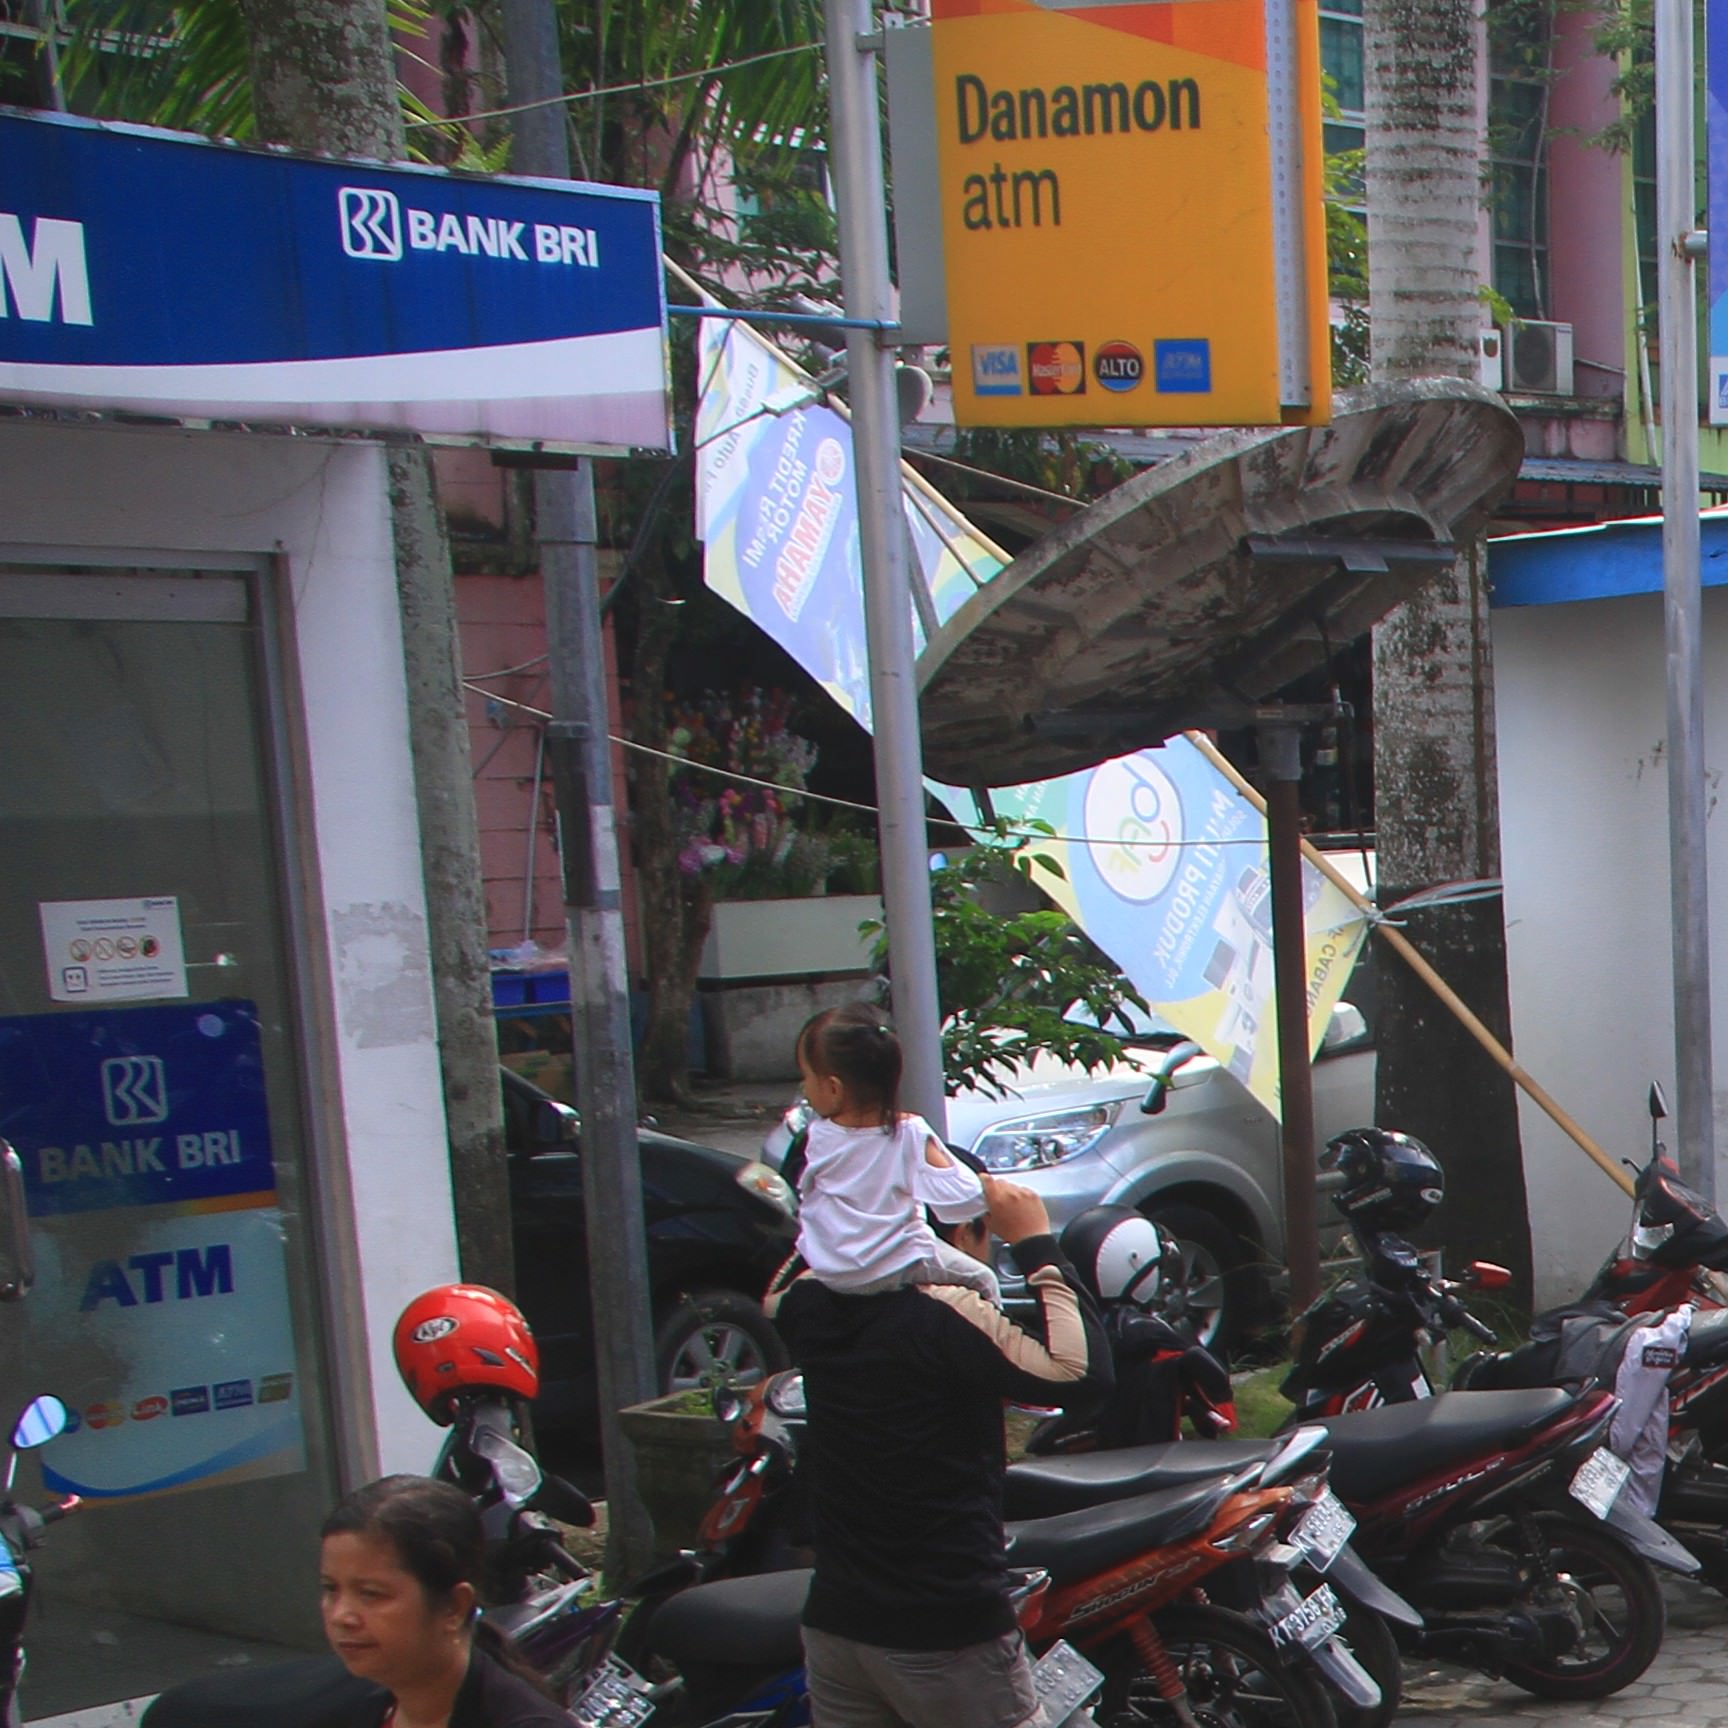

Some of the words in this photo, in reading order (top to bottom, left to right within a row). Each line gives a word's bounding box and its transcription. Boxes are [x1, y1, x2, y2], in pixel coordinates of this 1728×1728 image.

[955, 74, 1200, 144] Danamon
[962, 161, 1060, 230] atm
[409, 210, 529, 262] BANK
[537, 219, 599, 268] BRI
[979, 351, 1018, 375] VISA
[1099, 358, 1140, 376] ALTO
[40, 1138, 163, 1185] BANK
[178, 1128, 240, 1167] BRI
[80, 1245, 235, 1314] ATM
